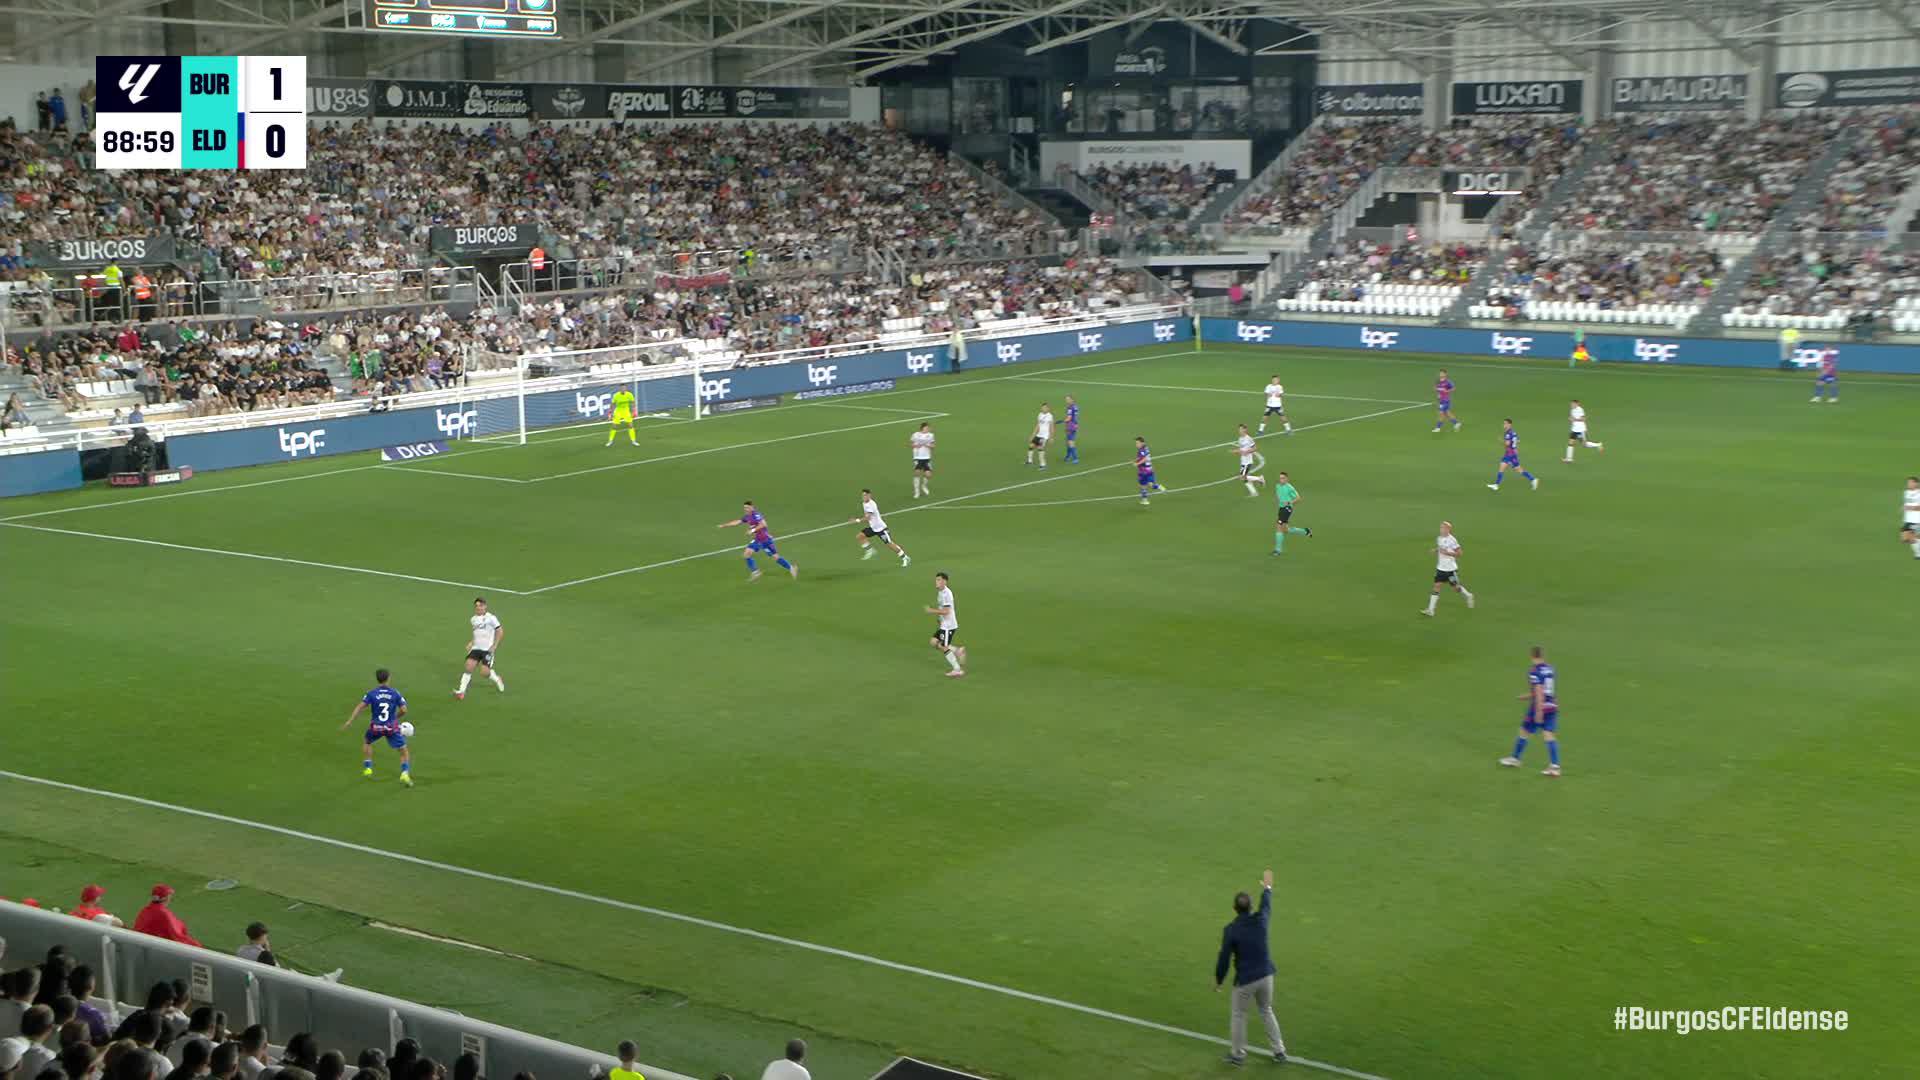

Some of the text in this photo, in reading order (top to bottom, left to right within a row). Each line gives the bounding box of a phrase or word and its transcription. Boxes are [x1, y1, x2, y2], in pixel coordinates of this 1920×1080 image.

[1475, 83, 1564, 105] LUXAN
[1458, 173, 1508, 191] DIGI
[455, 226, 517, 248] BURGOS
[60, 239, 146, 261] BURGOS
[906, 351, 933, 373] tpf
[807, 363, 838, 386] tpf
[576, 392, 611, 417] tpf
[397, 442, 440, 459] DIGI
[378, 702, 390, 722] 3
